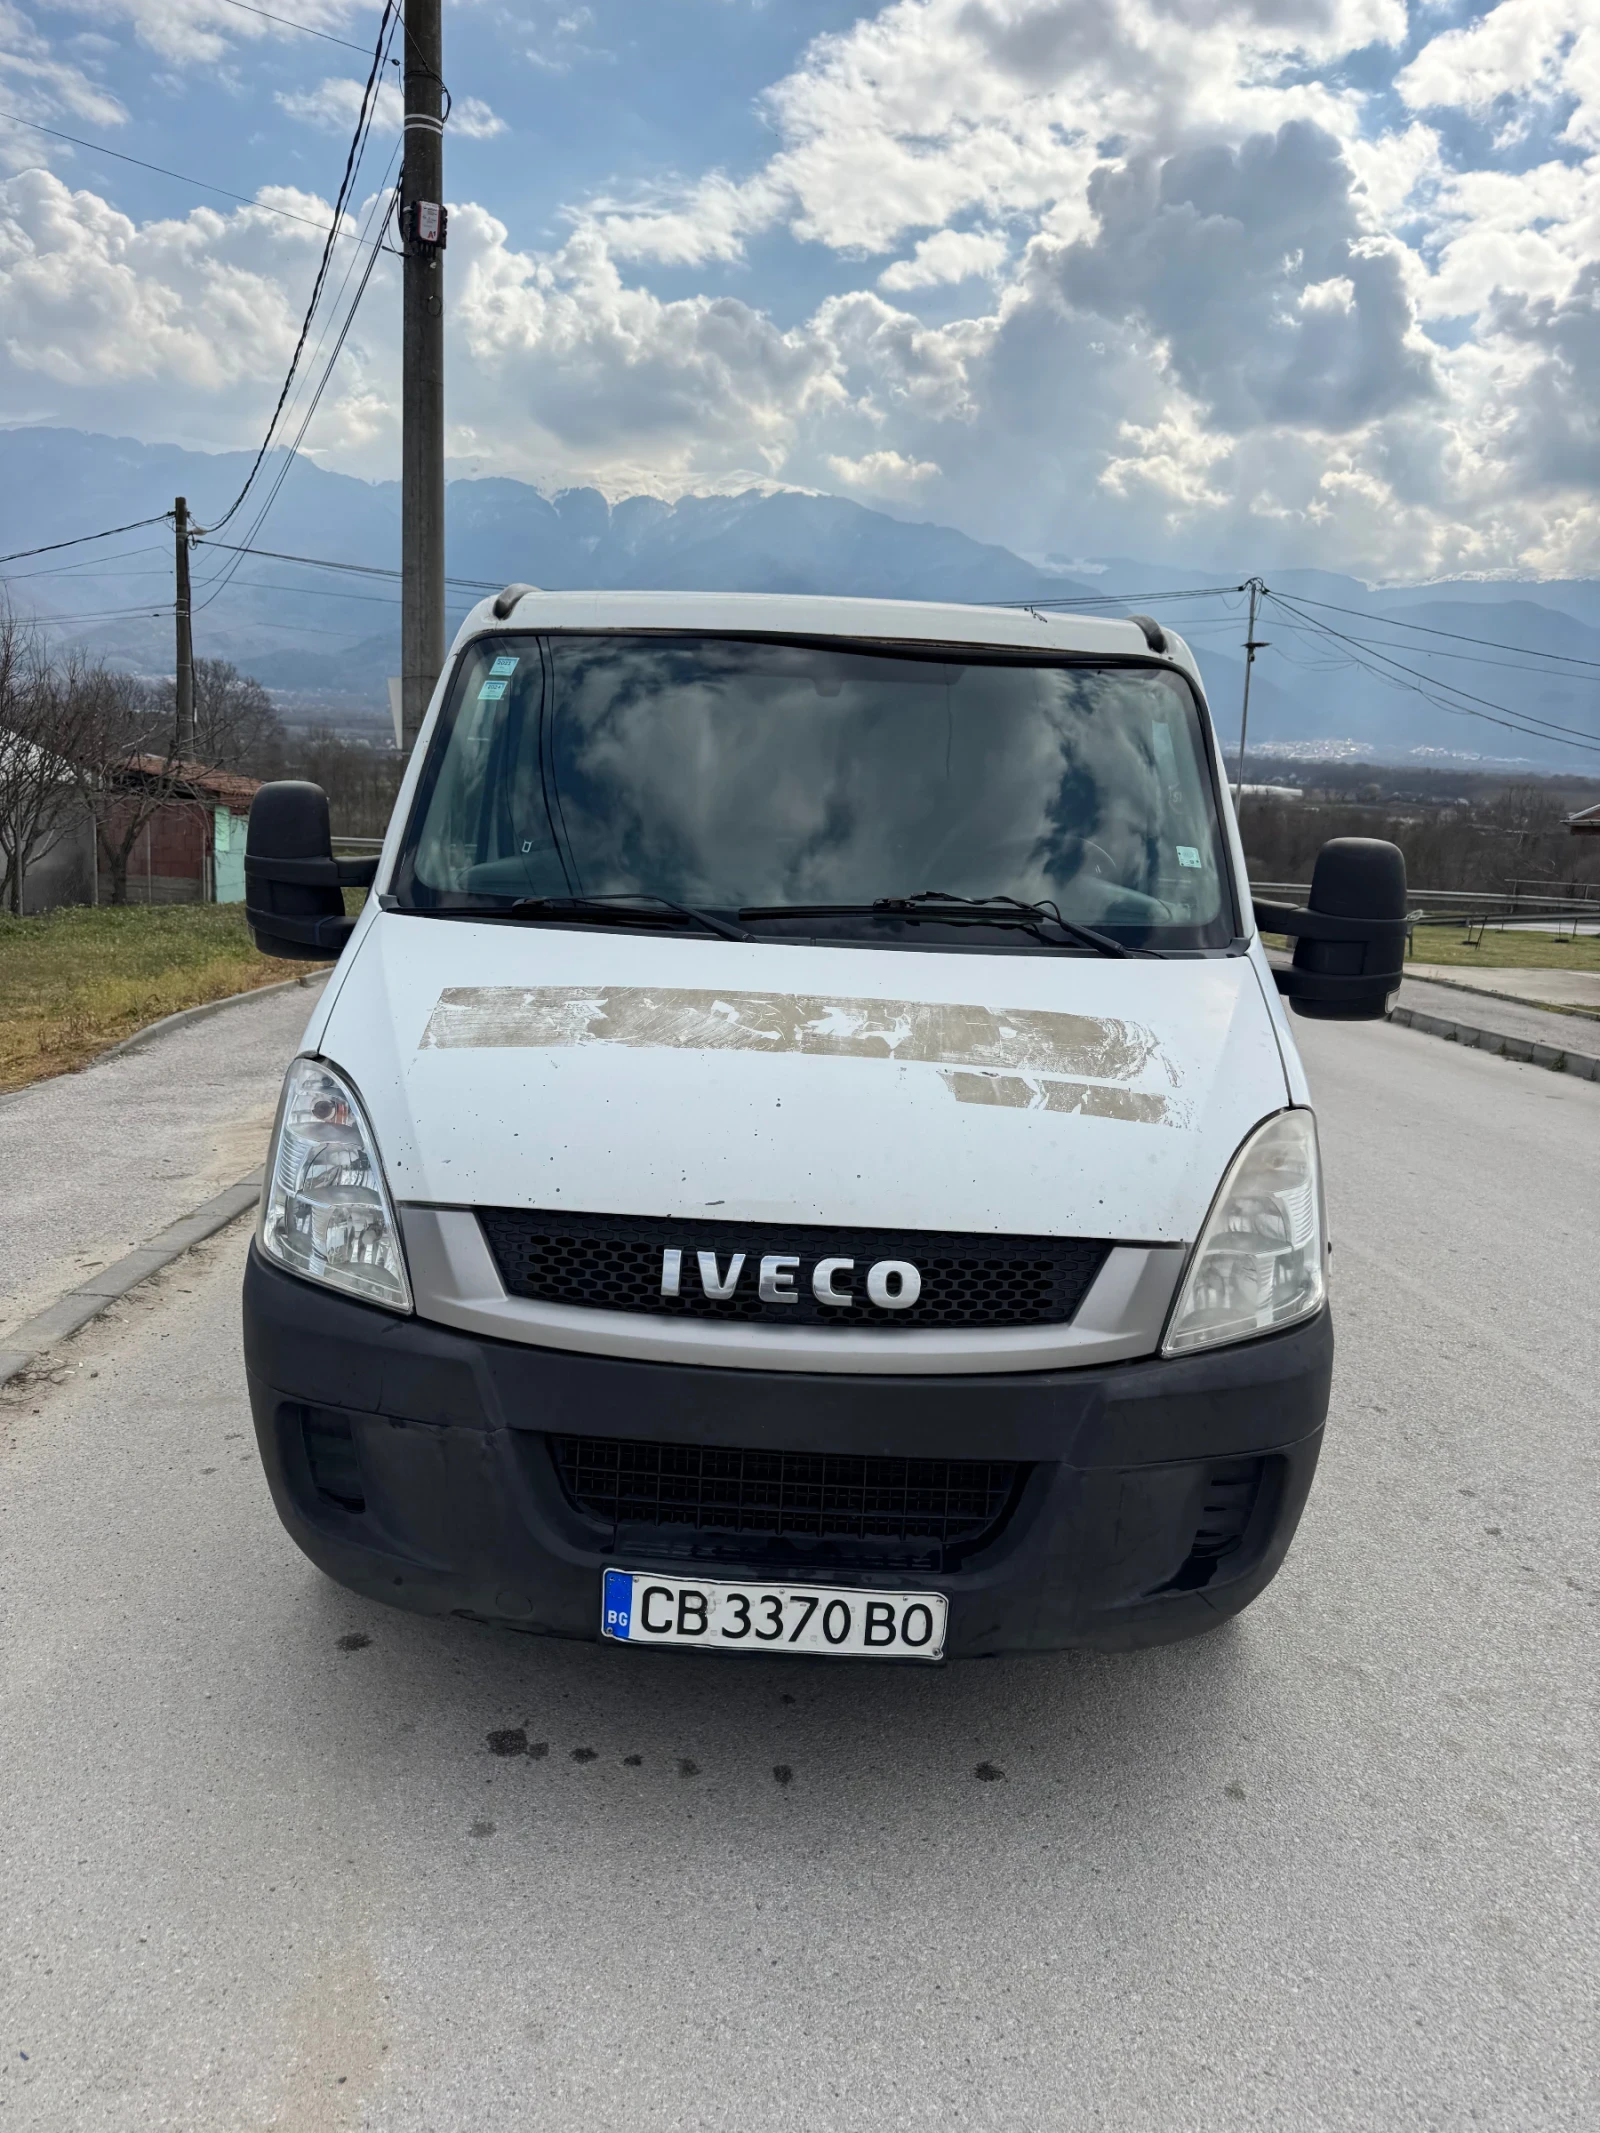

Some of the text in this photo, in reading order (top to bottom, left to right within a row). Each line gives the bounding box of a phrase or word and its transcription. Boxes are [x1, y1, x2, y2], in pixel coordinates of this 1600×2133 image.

[660, 1248, 922, 1310] IVECO
[607, 1609, 628, 1627] BG
[640, 1586, 709, 1636] CB
[721, 1593, 851, 1644] 3370
